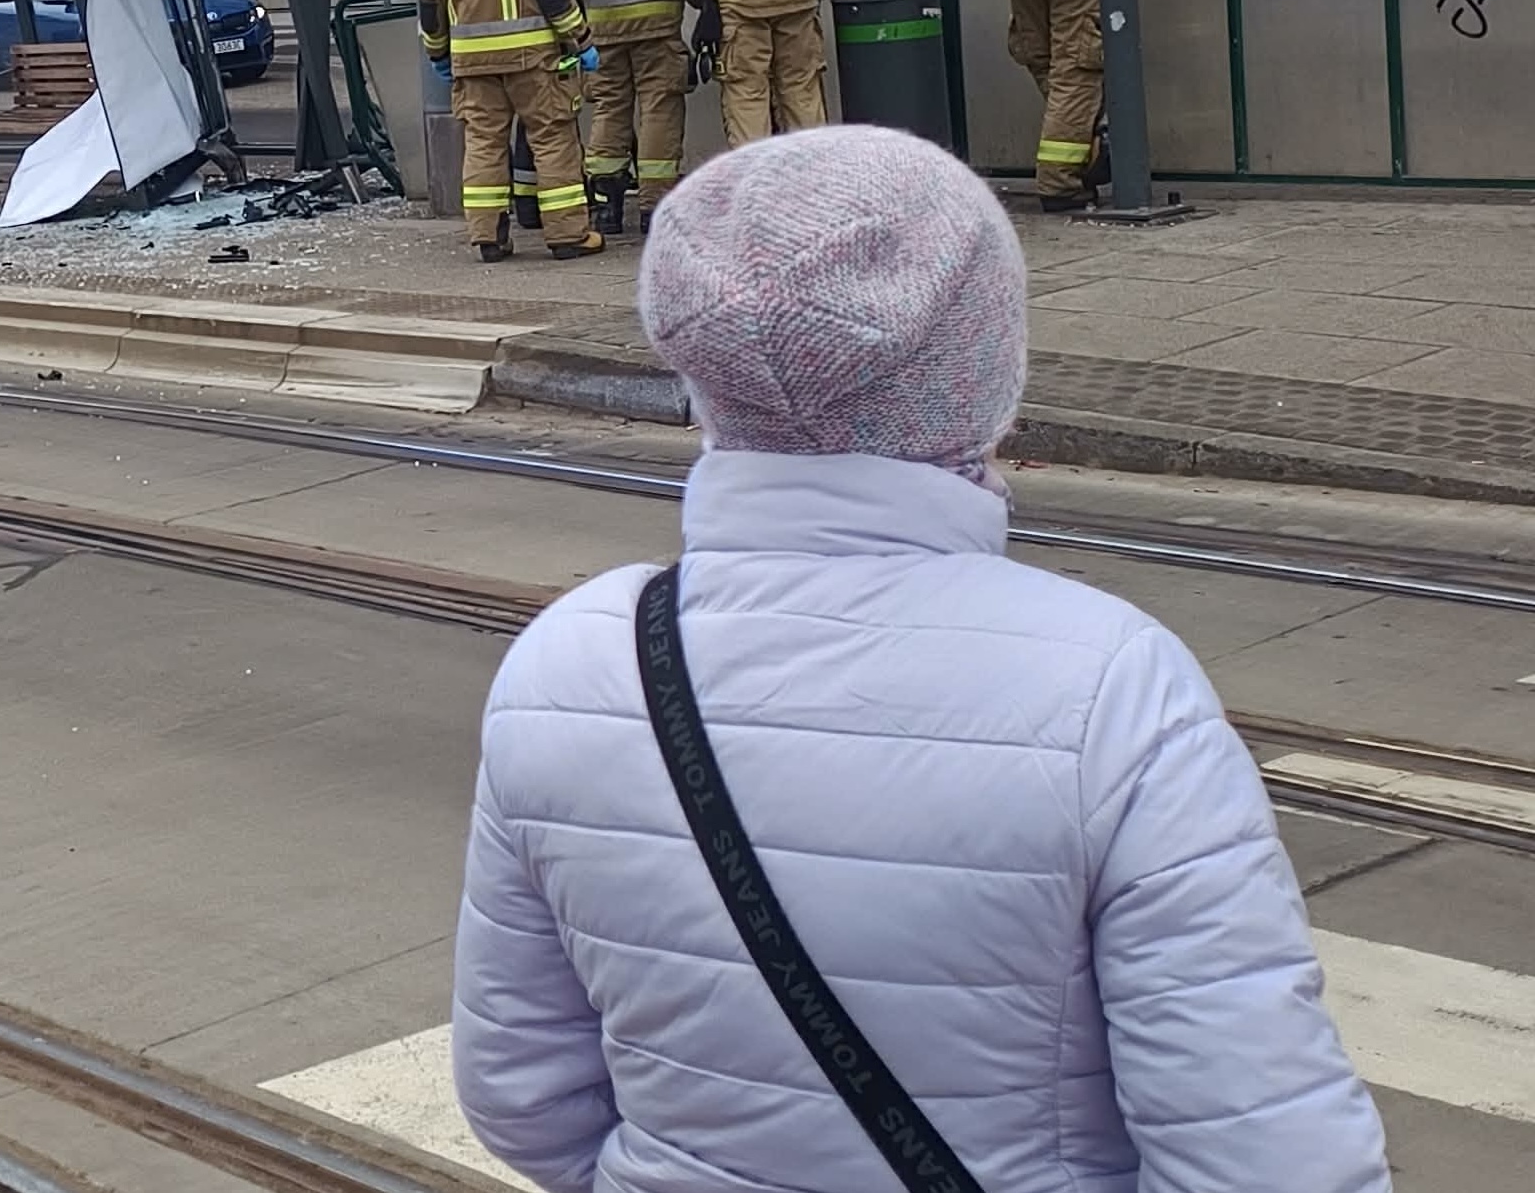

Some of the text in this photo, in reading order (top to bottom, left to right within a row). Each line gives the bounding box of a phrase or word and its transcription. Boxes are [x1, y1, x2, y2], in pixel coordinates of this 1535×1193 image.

[647, 584, 962, 1193] EANS TOMMY JEANS TOMMY JEANS
